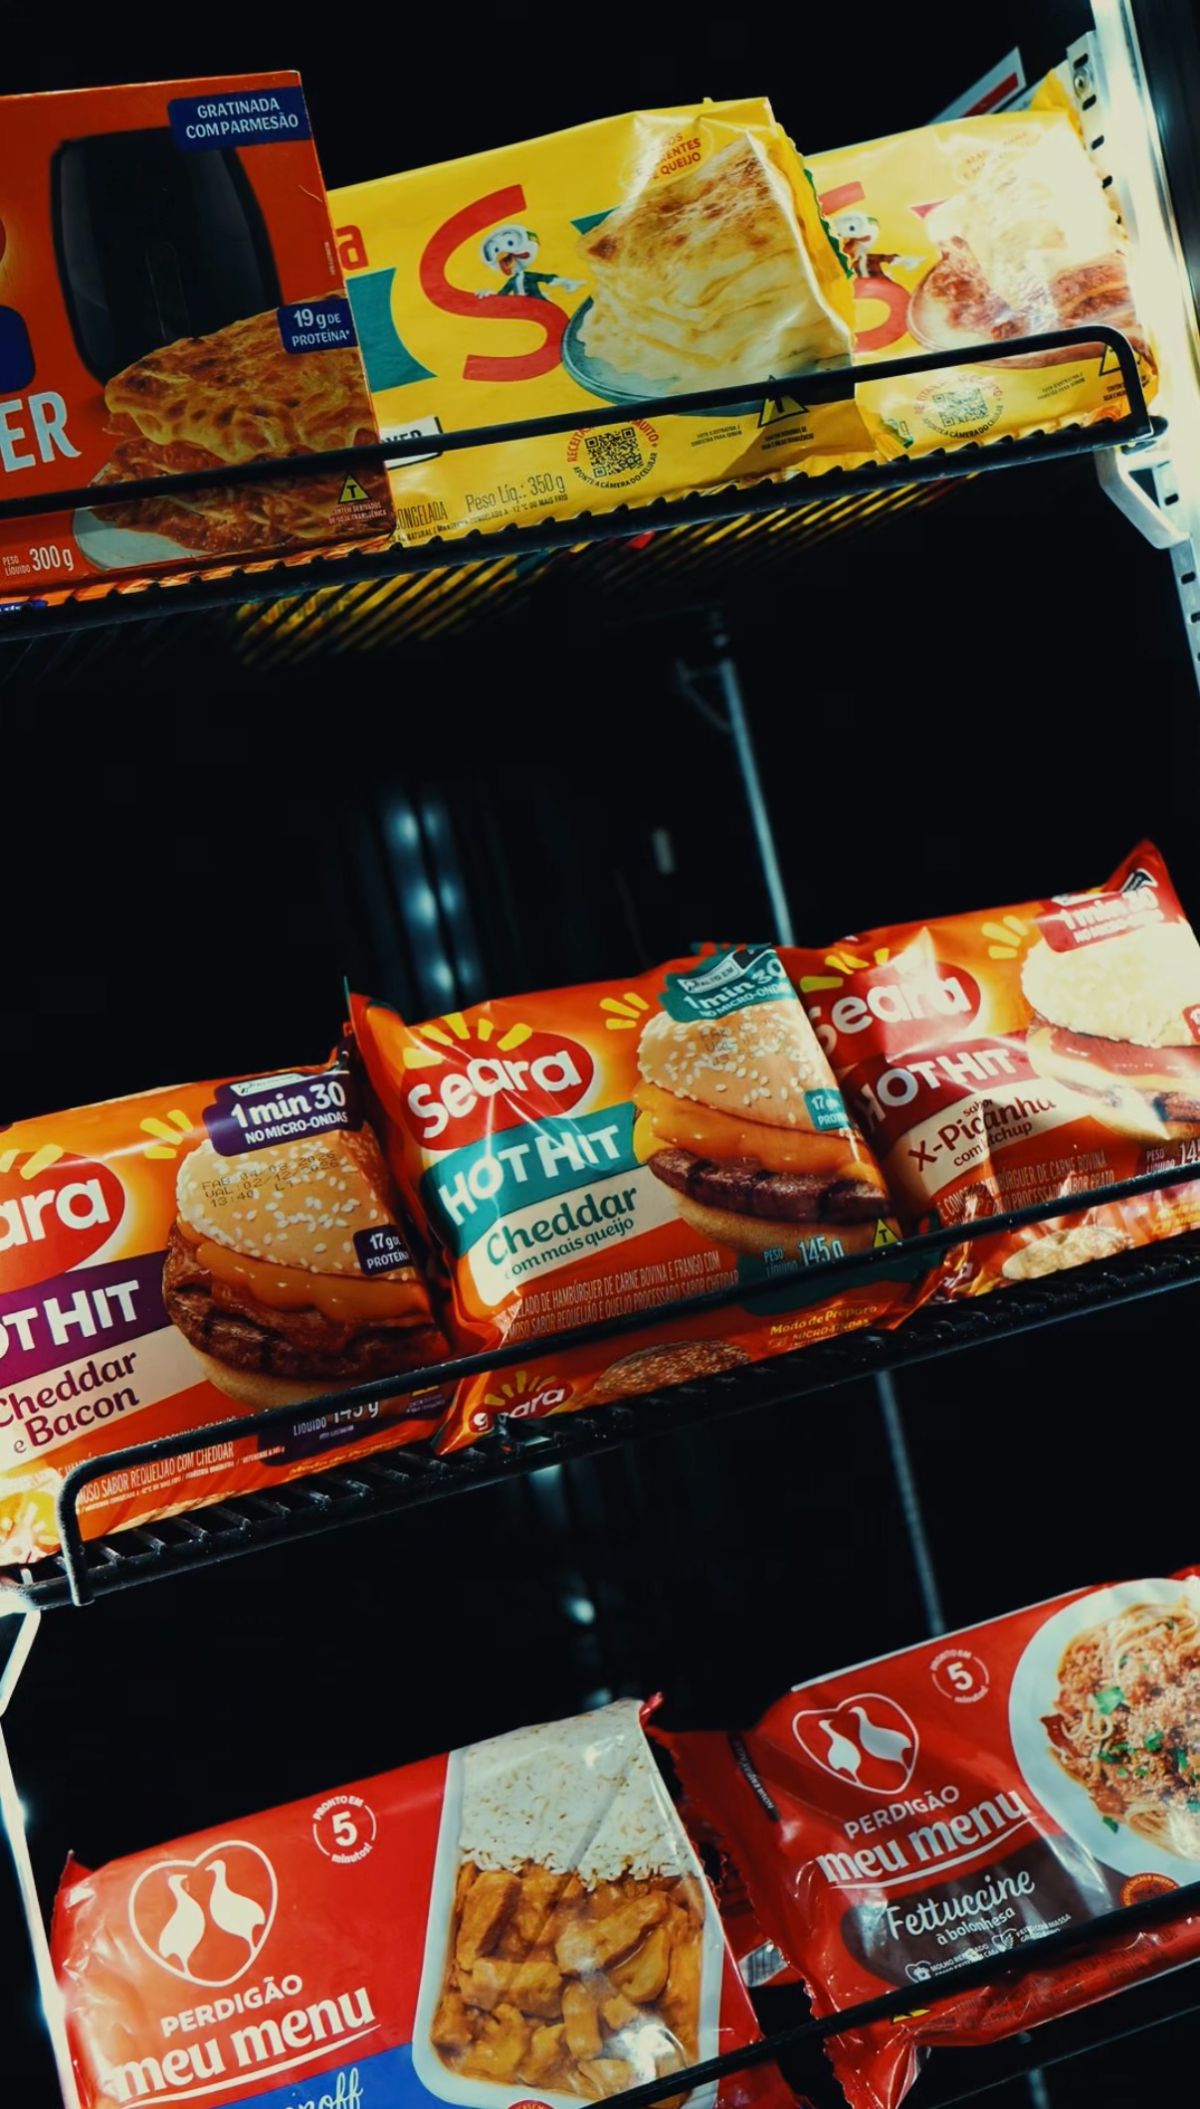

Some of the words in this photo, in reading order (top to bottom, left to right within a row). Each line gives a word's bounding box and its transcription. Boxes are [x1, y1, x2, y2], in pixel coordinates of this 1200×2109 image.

[186, 120, 220, 139] COM
[221, 112, 299, 135] PARMESÃO
[197, 97, 281, 119] GRATINADA
[660, 151, 701, 176] QUEIJO
[293, 308, 314, 328] 19
[315, 313, 327, 329] g
[327, 312, 342, 325] DE
[465, 491, 497, 513] Peso
[528, 473, 555, 496] 350
[555, 475, 566, 493] g
[29, 545, 61, 571] 300
[62, 548, 75, 571] g
[683, 995, 700, 1010] 1
[698, 981, 755, 1010] min
[751, 959, 781, 985] 30
[936, 1048, 1016, 1088] HIT
[231, 1103, 249, 1128] 1
[249, 1092, 312, 1125] min
[309, 1081, 346, 1109] 30
[408, 1051, 582, 1138] Seara
[244, 1129, 265, 1145] NO
[264, 1111, 348, 1140] MICRO-ONDAS
[953, 1142, 983, 1167] com
[438, 1144, 530, 1226] HOT
[534, 1124, 622, 1178] HIT
[370, 1232, 384, 1250] 17
[486, 1187, 637, 1266] Cheddar
[541, 1238, 585, 1263] mais
[585, 1217, 634, 1247] queijo
[763, 1247, 784, 1262] PESO
[799, 1236, 831, 1266] 145
[603, 1275, 614, 1296] DE
[614, 1268, 640, 1293] CARNE
[704, 1250, 721, 1273] COM
[43, 1280, 140, 1346] HIT
[770, 1319, 807, 1336] Modo
[807, 1315, 824, 1327] de
[13, 1439, 26, 1454] e
[24, 1386, 141, 1448] Bacon
[100, 1472, 130, 1498] SABOR
[177, 1451, 195, 1474] COM
[196, 1440, 235, 1466] CHEDDAR
[947, 1661, 973, 1691] 5
[312, 1794, 348, 1821] PRONTO
[348, 1794, 364, 1808] EM
[843, 1785, 960, 1839] PERDIGÃO
[332, 1810, 358, 1847] 5
[815, 1839, 909, 1883] meu
[908, 1790, 1031, 1862] menu
[886, 1871, 1037, 1942] Fettuccine
[935, 1932, 949, 1946] à
[945, 1907, 1016, 1942] bolonhesa
[160, 1974, 303, 2038] PERDIGÃO
[114, 2038, 226, 2103] meu
[231, 1986, 376, 2068] menu
